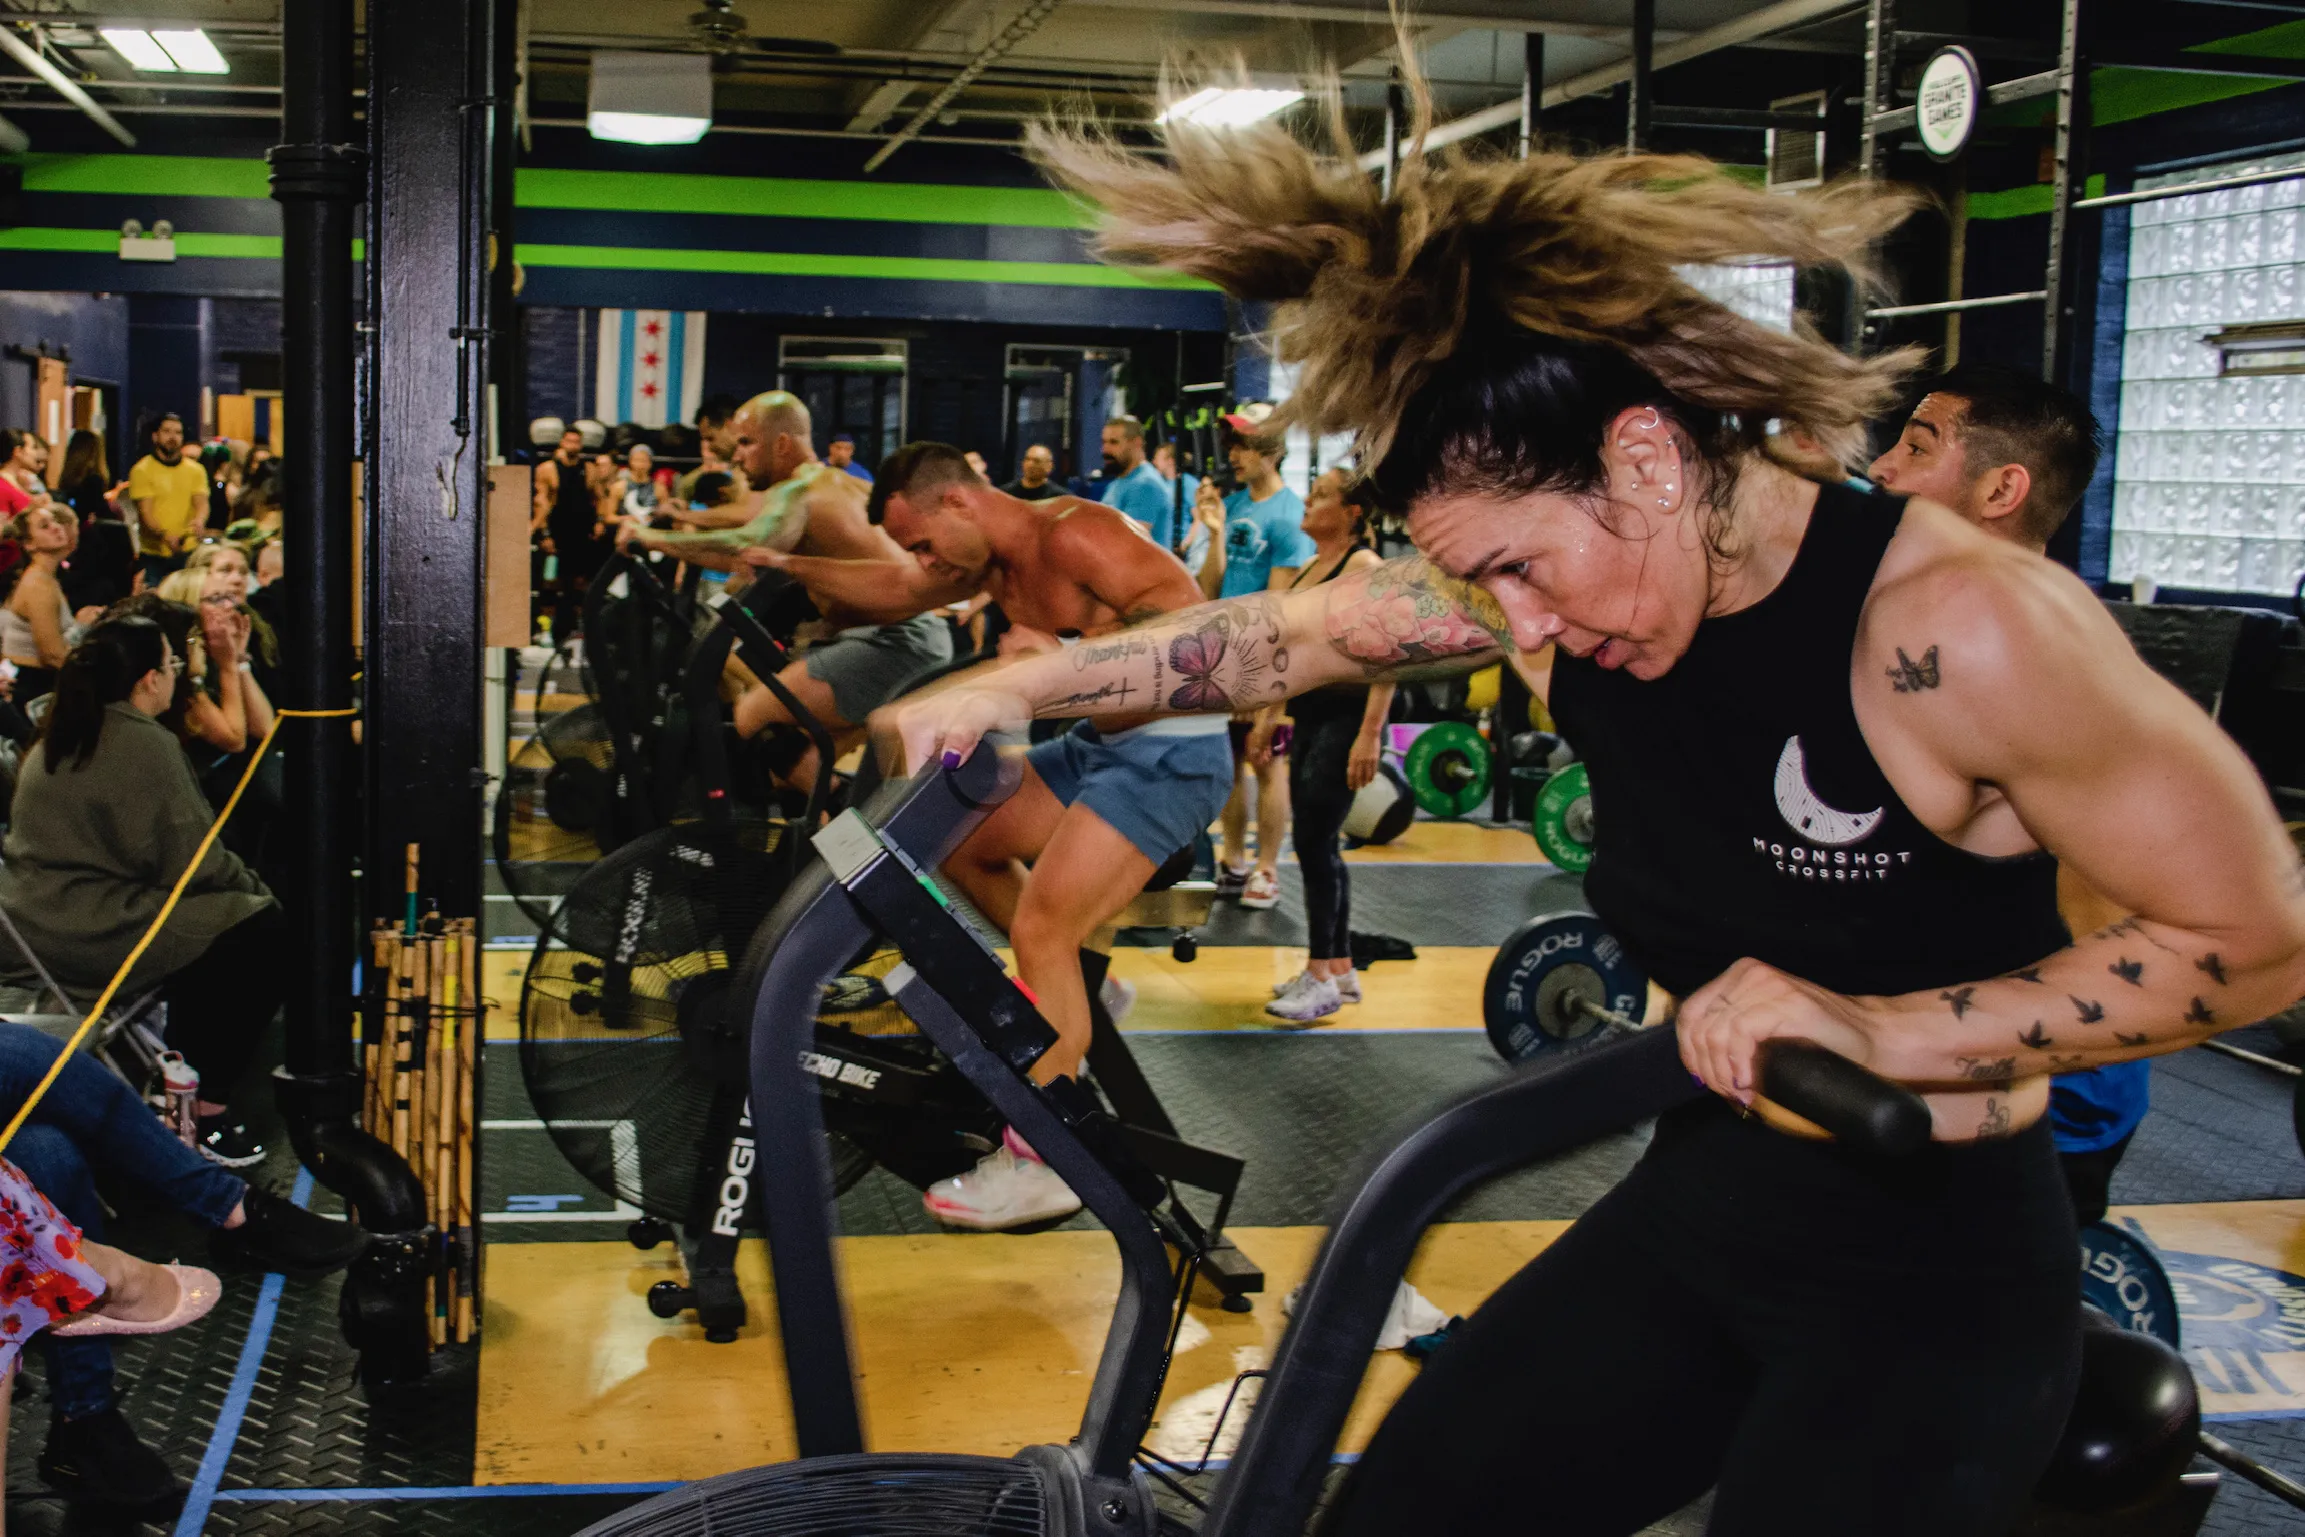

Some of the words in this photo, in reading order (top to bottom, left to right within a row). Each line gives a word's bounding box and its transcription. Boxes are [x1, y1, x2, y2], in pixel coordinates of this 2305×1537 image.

[1752, 836, 1910, 865] MOONSHOT
[1776, 860, 1887, 880] CROSSFIT
[1504, 931, 1584, 1013] ROGUE
[798, 1050, 843, 1080] ECHO
[836, 1061, 882, 1091] BIKE
